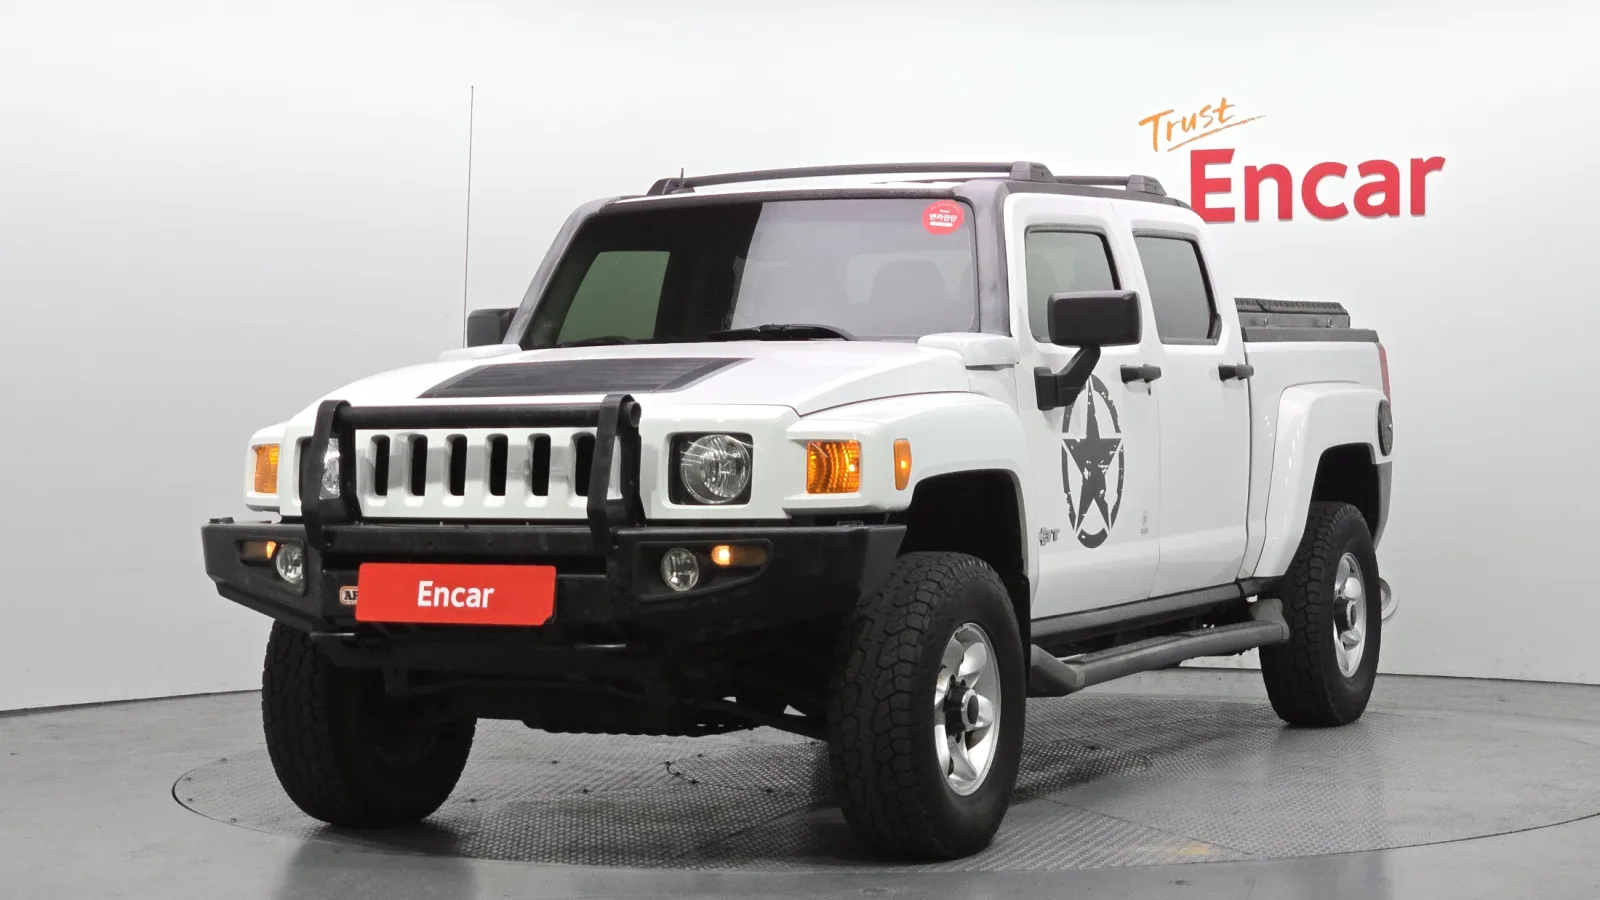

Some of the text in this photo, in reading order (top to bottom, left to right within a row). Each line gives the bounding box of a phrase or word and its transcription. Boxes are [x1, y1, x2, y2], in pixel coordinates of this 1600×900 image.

[1138, 97, 1237, 152] Trust
[1190, 148, 1445, 222] Encar
[417, 580, 495, 608] Encar
